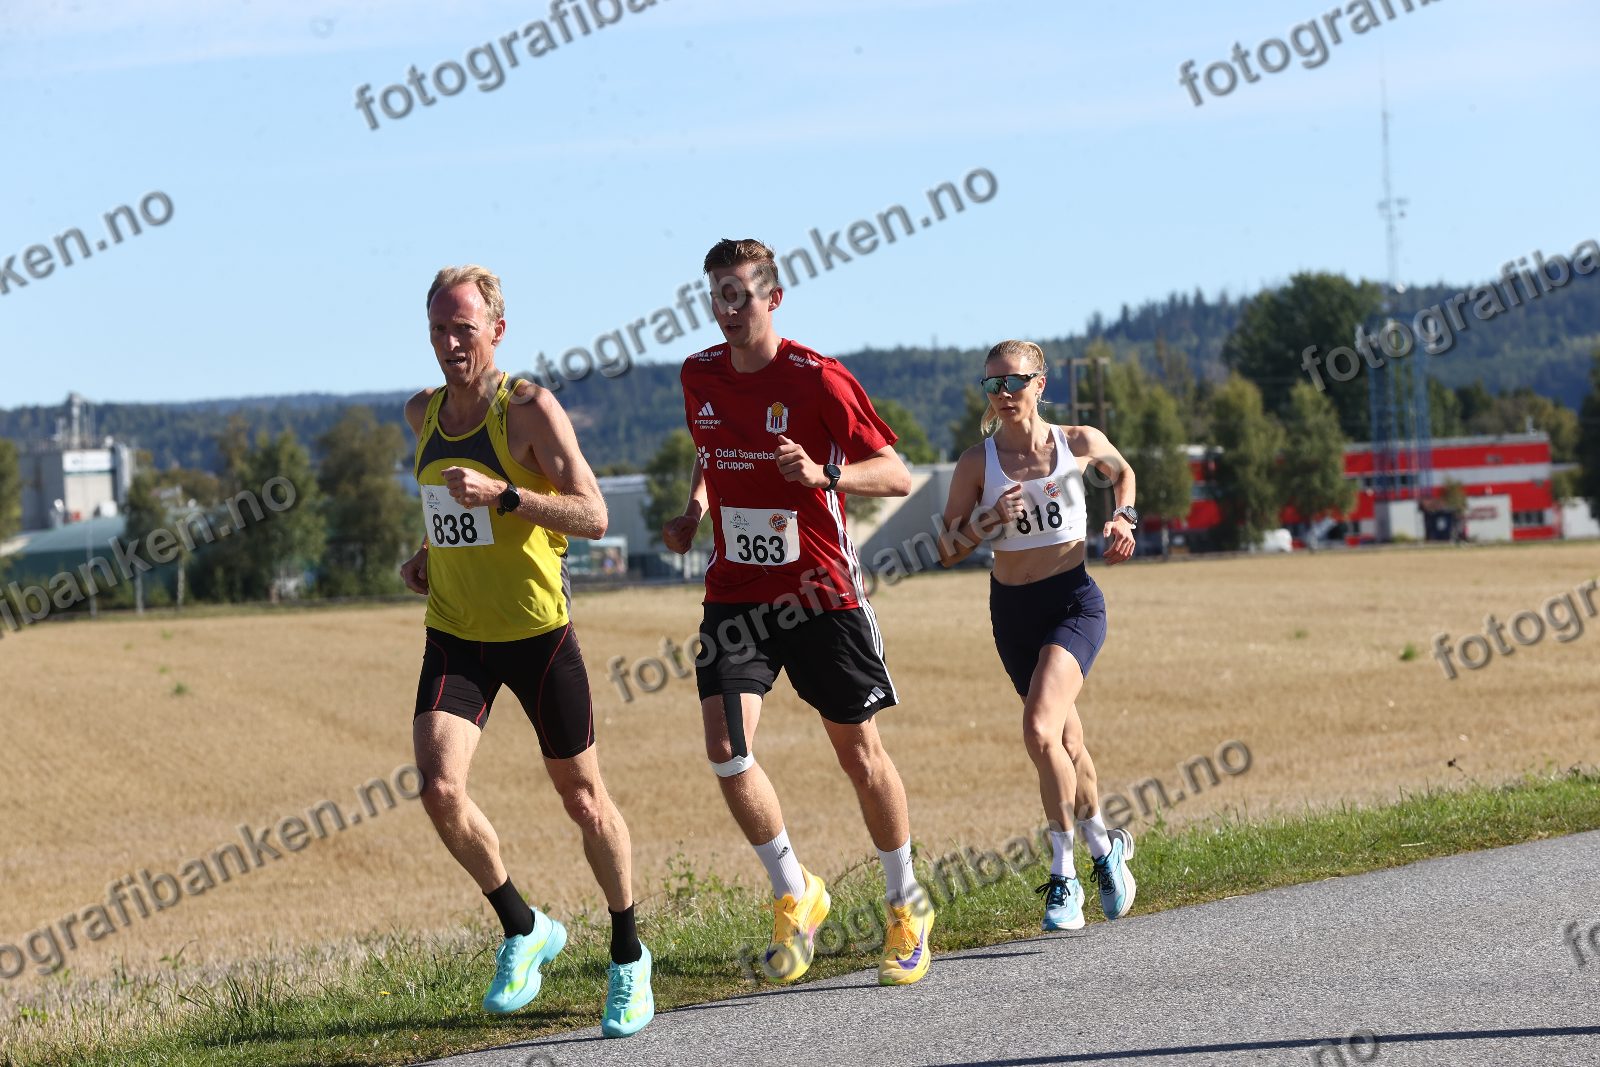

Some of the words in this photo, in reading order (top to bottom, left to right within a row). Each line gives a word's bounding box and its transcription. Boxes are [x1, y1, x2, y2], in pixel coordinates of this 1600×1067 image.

[715, 448, 738, 458] Odal
[716, 460, 755, 471] Gruppen
[432, 512, 478, 546] 838
[1016, 501, 1063, 535] 818
[736, 534, 785, 564] 363
